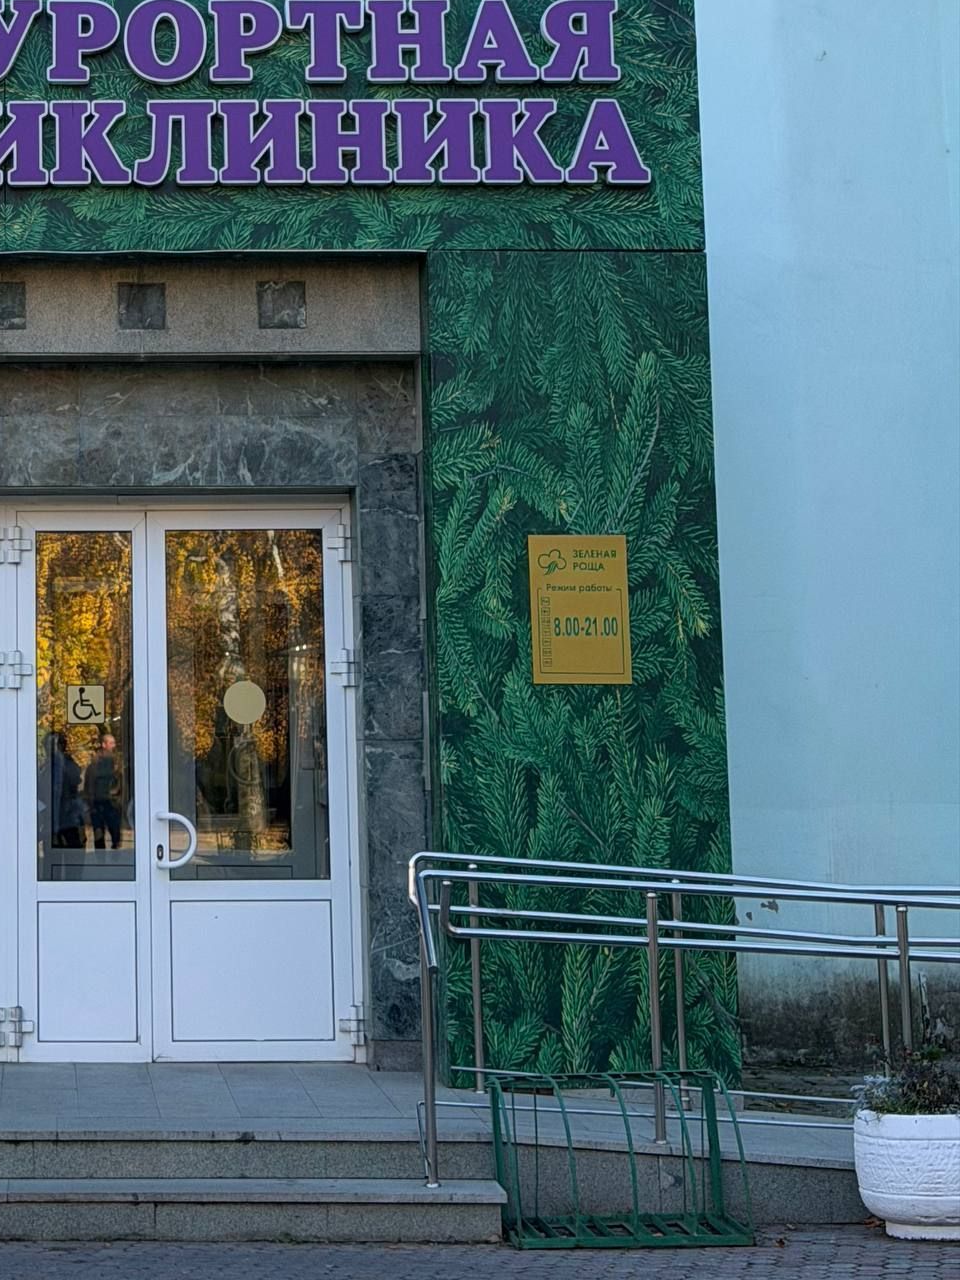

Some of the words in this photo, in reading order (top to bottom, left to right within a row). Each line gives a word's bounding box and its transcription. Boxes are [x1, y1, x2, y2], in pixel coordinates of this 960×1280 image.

[573, 549, 617, 559] ЗЕЛЕНАЯ
[573, 562, 605, 571] РОЩА
[546, 584, 576, 592] Режим
[579, 584, 612, 593] работы
[553, 617, 618, 637] 8.00-21.00
